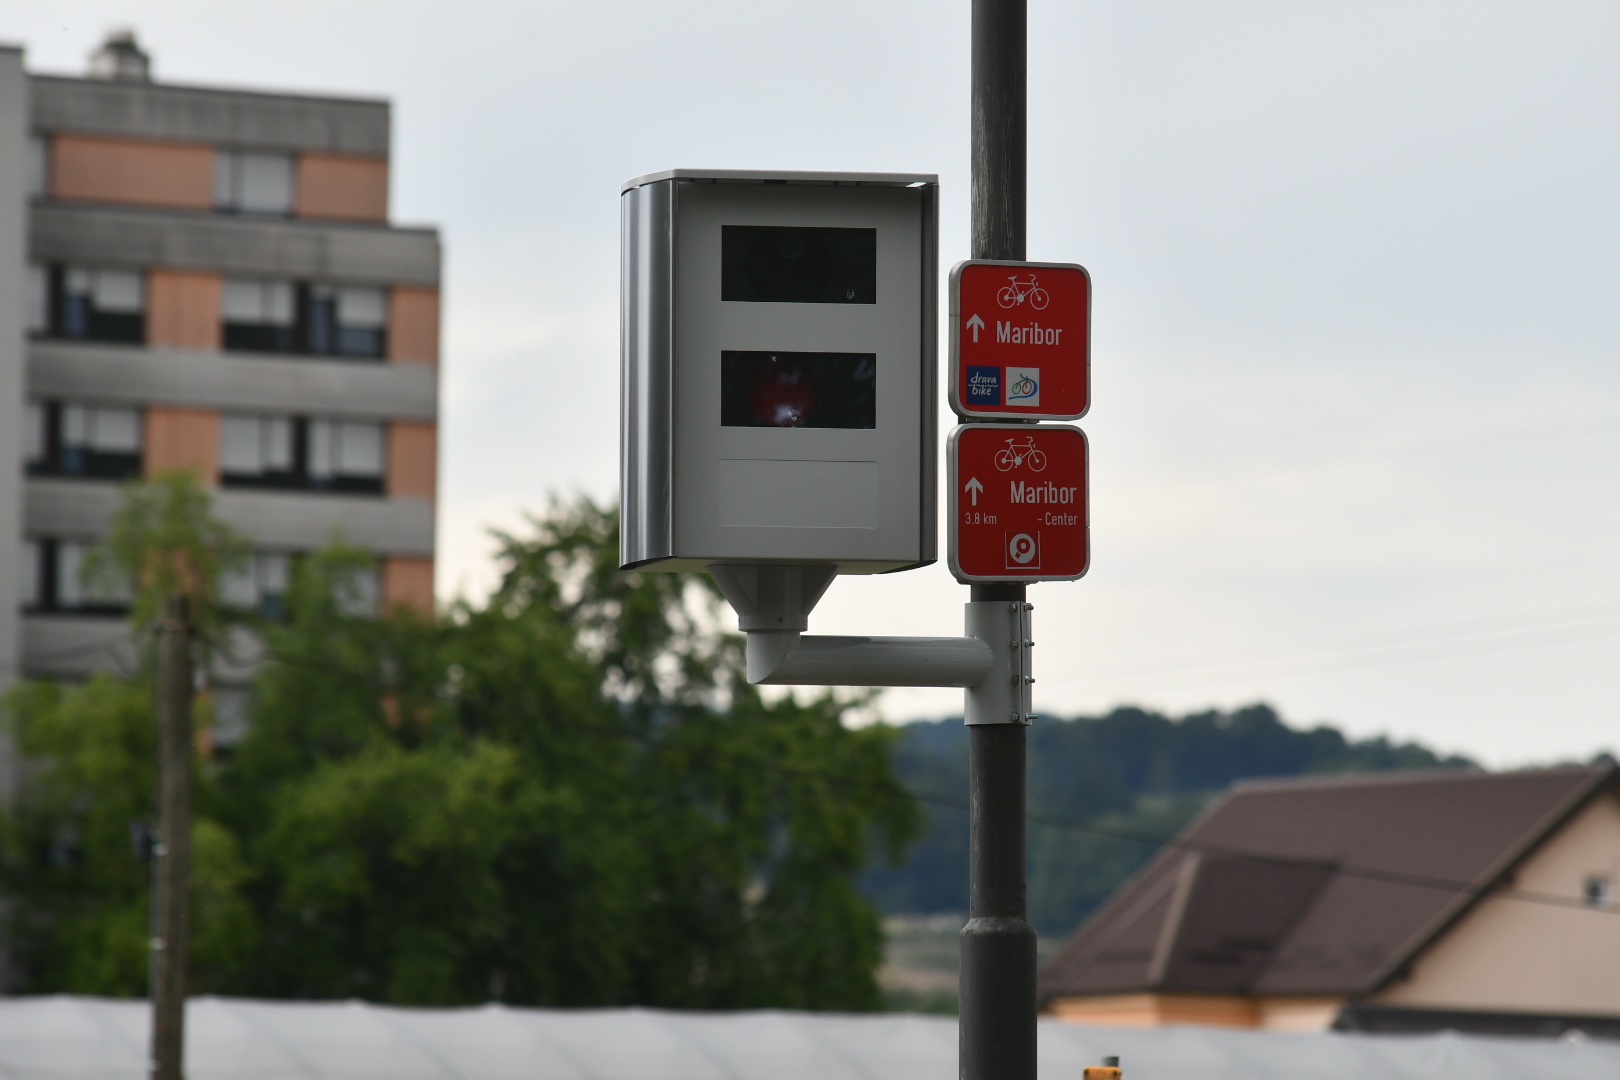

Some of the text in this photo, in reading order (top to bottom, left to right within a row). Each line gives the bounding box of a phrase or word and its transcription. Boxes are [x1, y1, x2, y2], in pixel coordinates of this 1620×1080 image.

[997, 321, 1063, 345] Maribor
[970, 371, 997, 384] drava
[971, 384, 992, 396] bike
[1010, 481, 1077, 504] Maribor
[983, 512, 997, 525] km
[1045, 512, 1078, 526] Center
